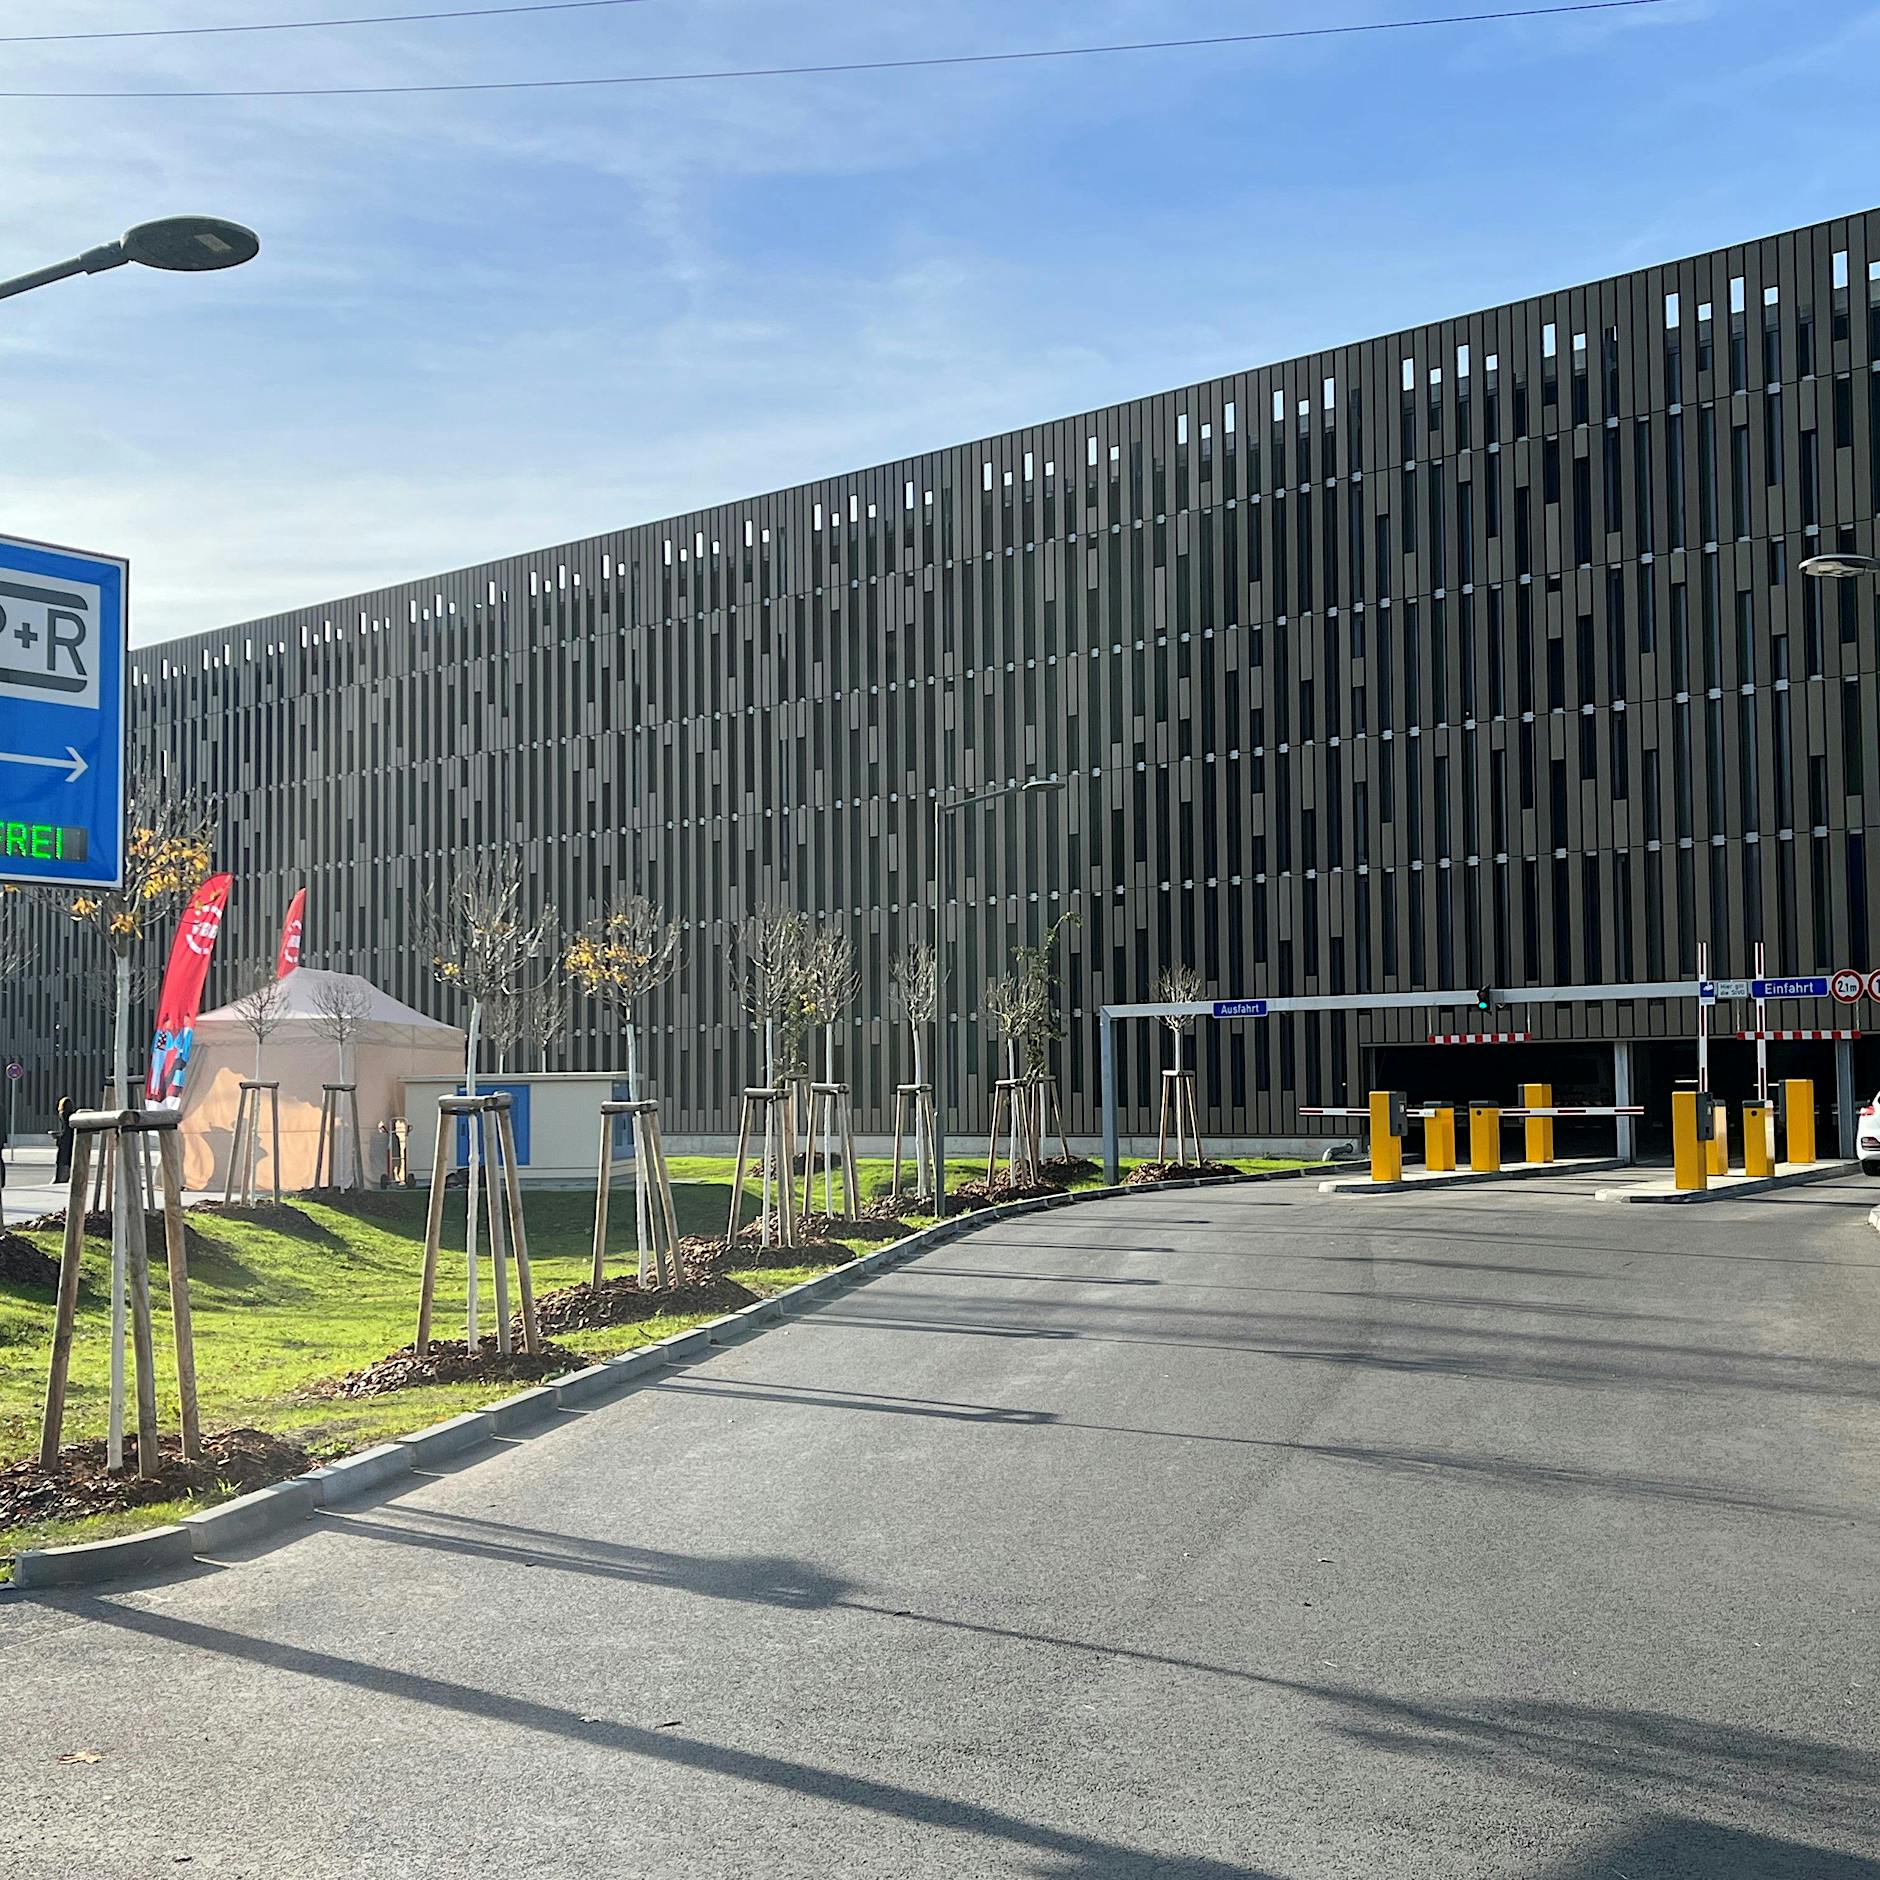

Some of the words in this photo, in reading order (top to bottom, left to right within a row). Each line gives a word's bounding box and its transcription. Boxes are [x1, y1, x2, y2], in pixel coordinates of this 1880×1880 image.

[0, 604, 87, 676] +R
[0, 822, 63, 860] REI
[1764, 981, 1814, 995] Einfahrt
[1220, 1003, 1260, 1015] Ausfahrt
